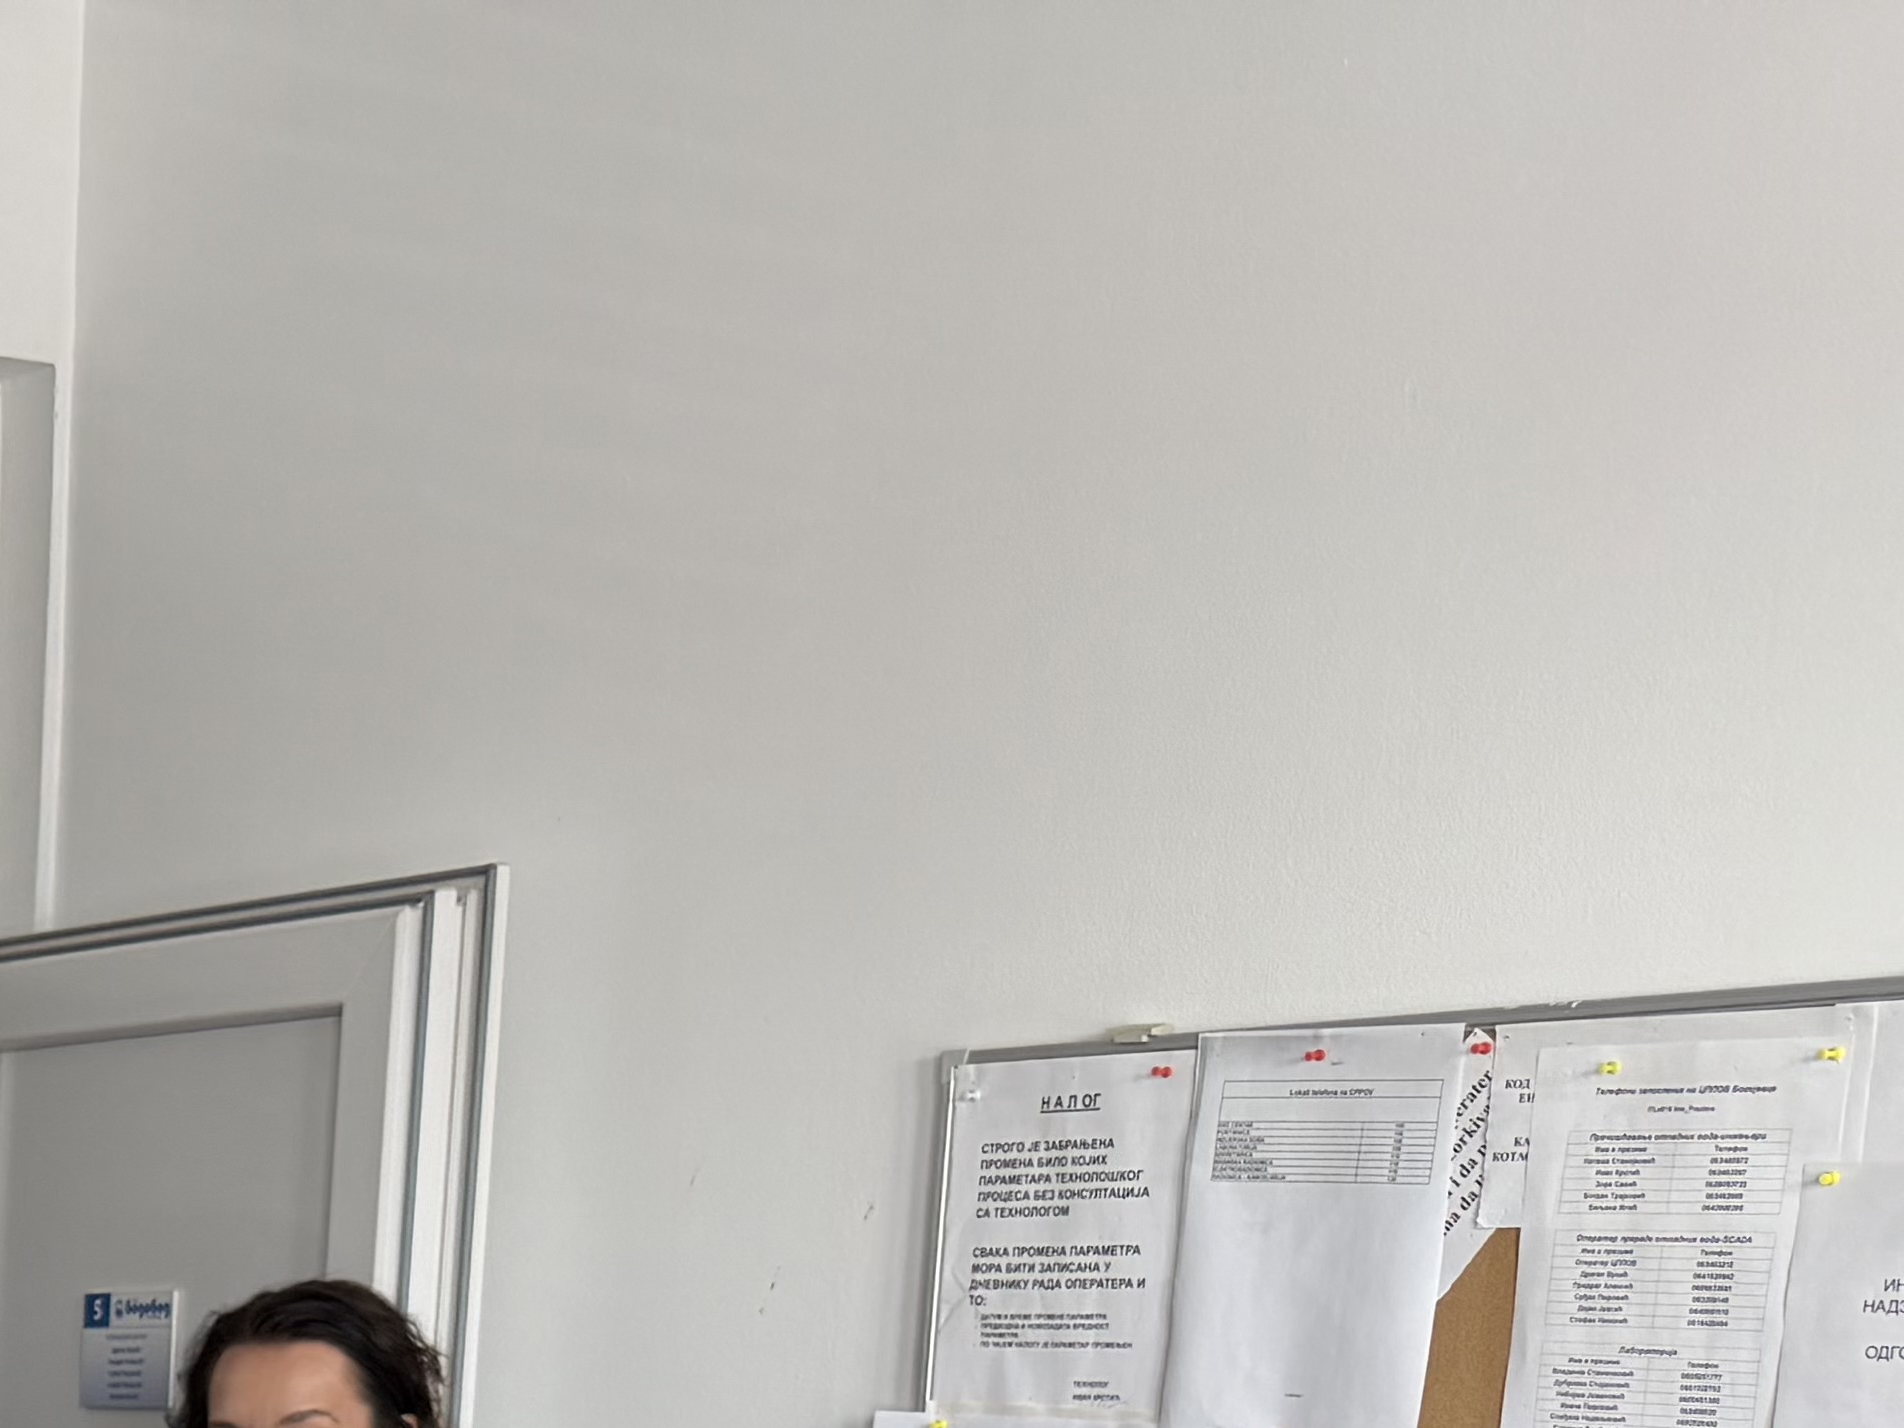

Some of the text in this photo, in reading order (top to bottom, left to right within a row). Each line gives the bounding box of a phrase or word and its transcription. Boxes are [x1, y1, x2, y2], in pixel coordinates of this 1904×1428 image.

[981, 1138, 1115, 1154] СТРОГО ЈЕ ЗАБРАЊЕНА
[980, 1154, 1108, 1169] ПРОМЕНА БИЛО КОЈИХ
[978, 1169, 1144, 1186] ПАРАМЕТАРА ТЕХНОЛОШКОГ
[977, 1186, 1150, 1203] ПРОЦЕСА БЕЗ КОНСУЛТАЦИЈА
[976, 1205, 1070, 1219] СА ТЕХНОЛОГОМ
[972, 1244, 1141, 1259] СВАКА ПРОМЕНА ПАРАМЕТРА
[971, 1261, 1112, 1274] МОРА БИТИ ЗАПИСАНА У
[969, 1277, 1146, 1292] ДНЕВНИКУ РАДА ОПЕРАТЕРА И
[969, 1294, 987, 1306] ТО:
